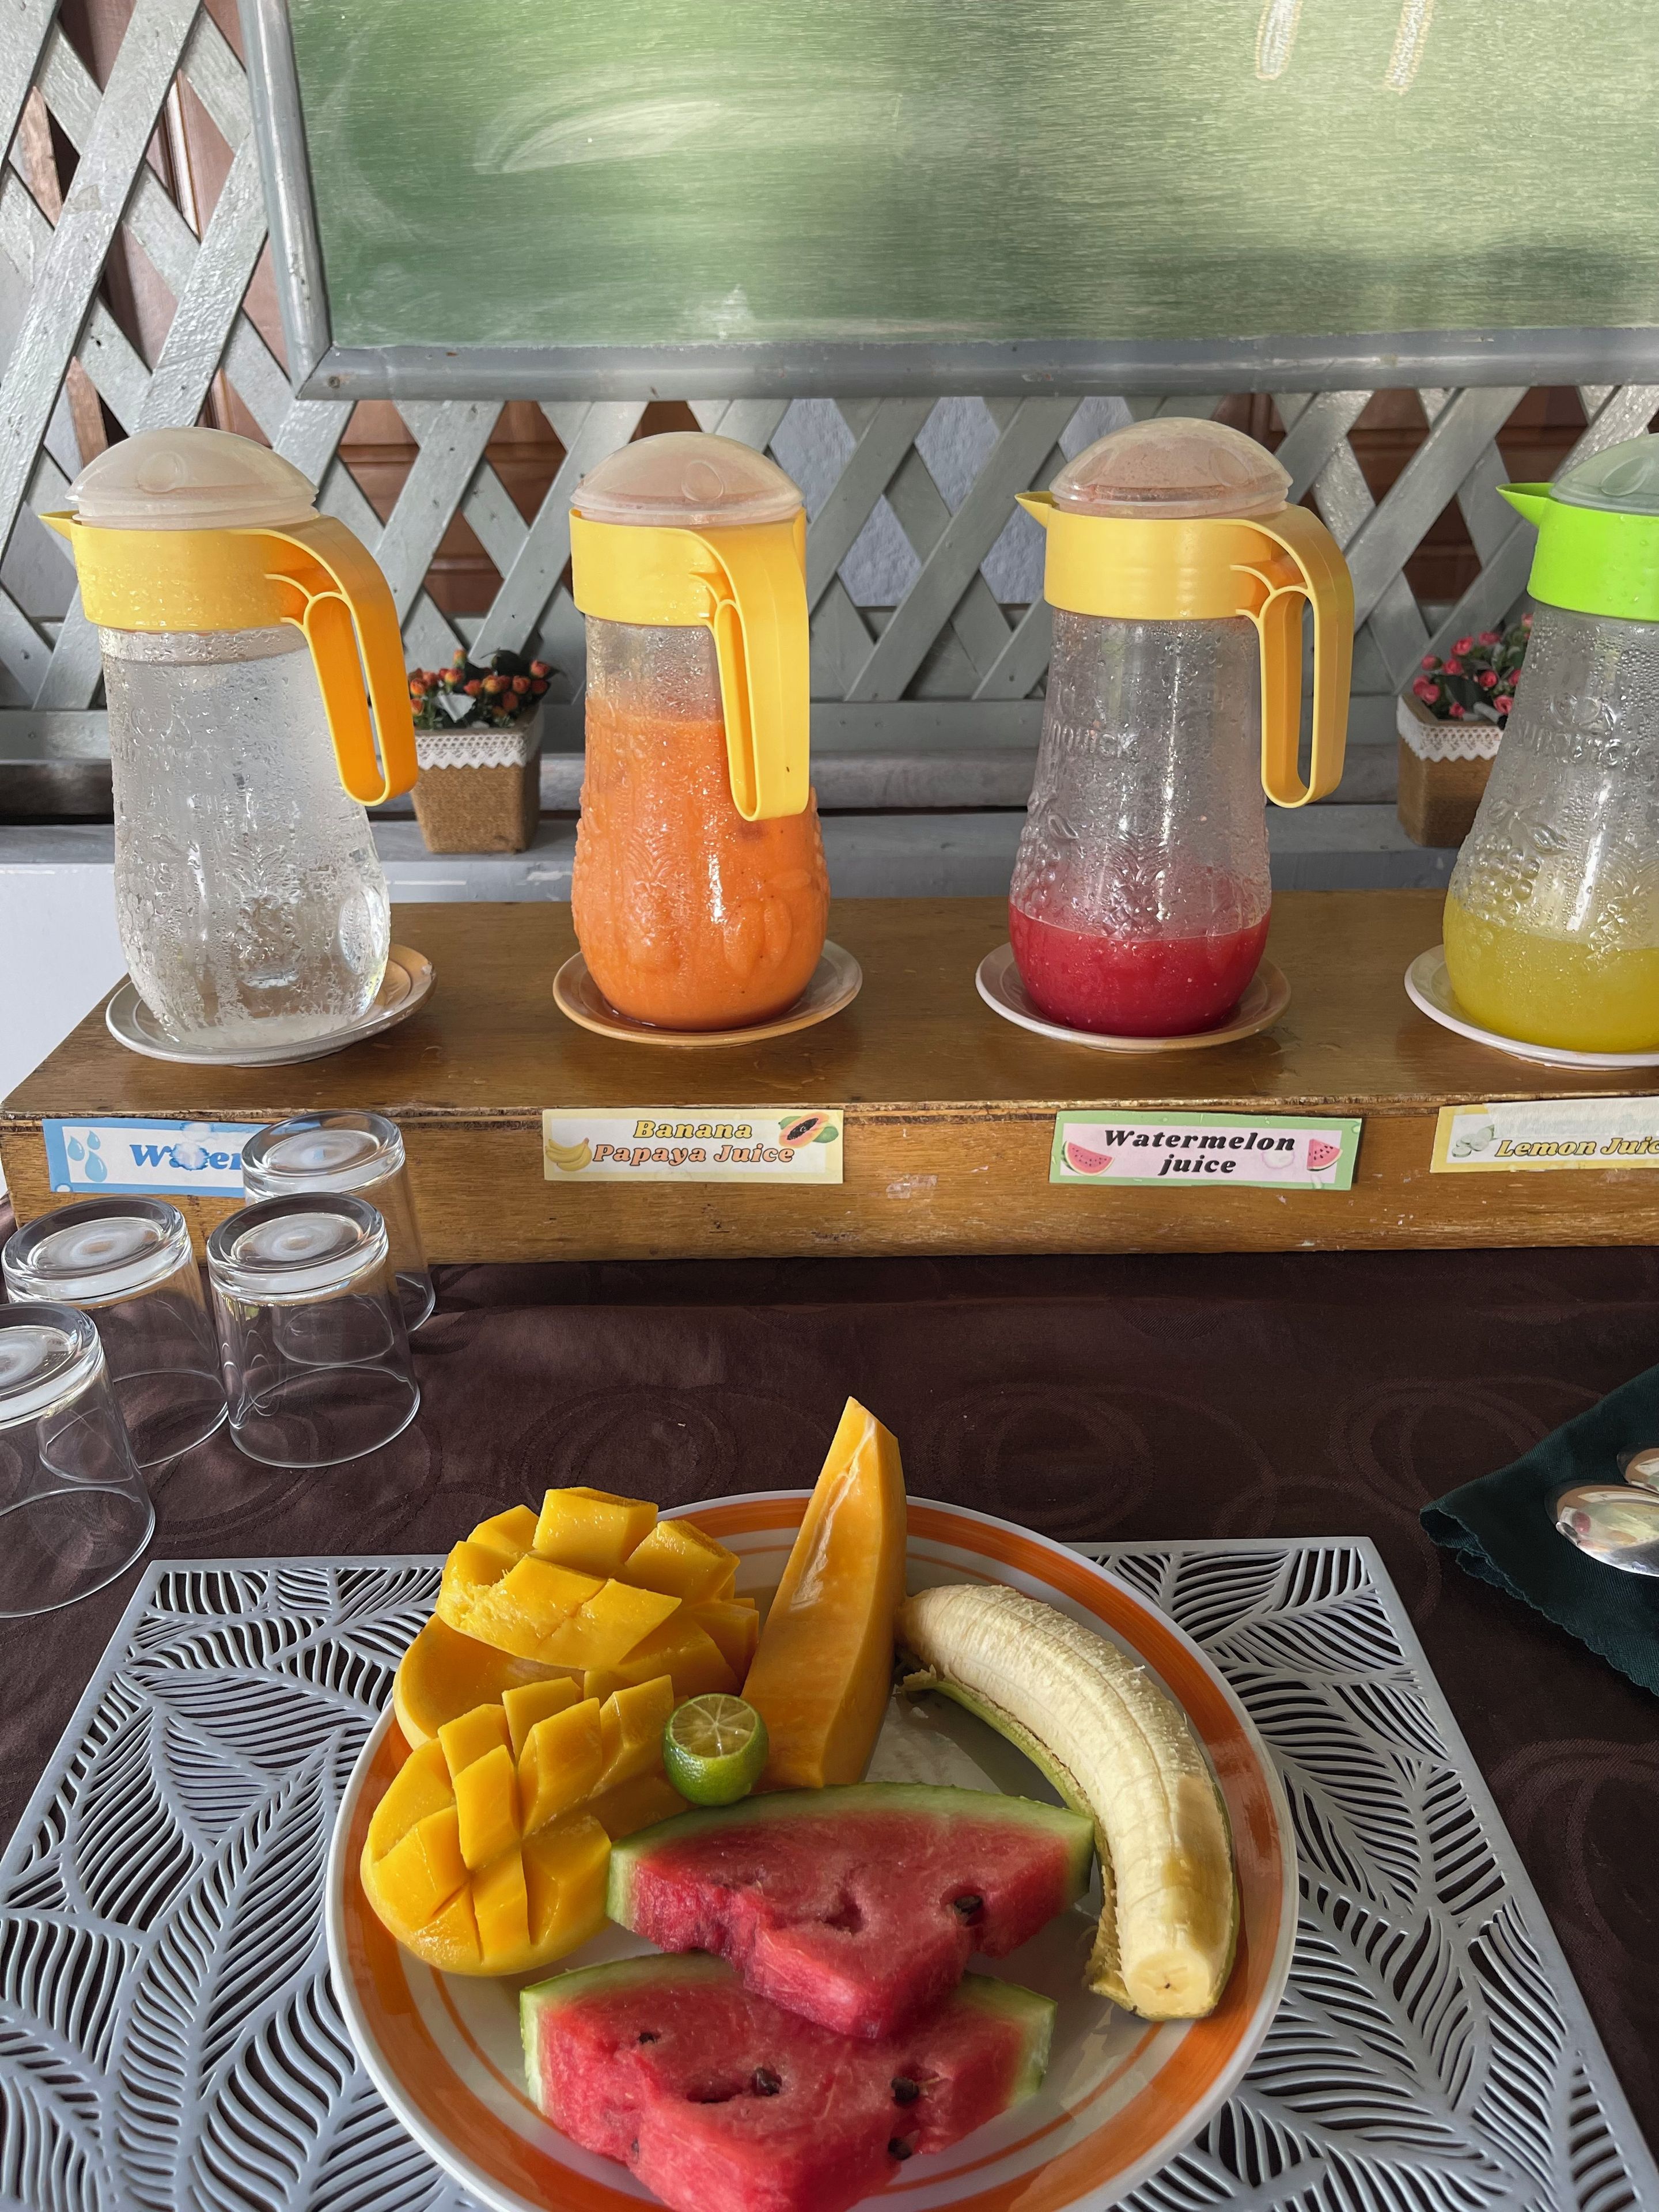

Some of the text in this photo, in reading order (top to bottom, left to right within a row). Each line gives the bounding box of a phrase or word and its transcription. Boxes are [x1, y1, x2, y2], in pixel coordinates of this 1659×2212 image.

[633, 1120, 752, 1139] Banana
[1104, 1130, 1296, 1152] Watermelon
[1494, 1140, 1597, 1157] Lemon
[129, 1145, 241, 1171] Wer
[593, 1143, 795, 1166] Papaya Juice
[1158, 1154, 1237, 1176] juice
